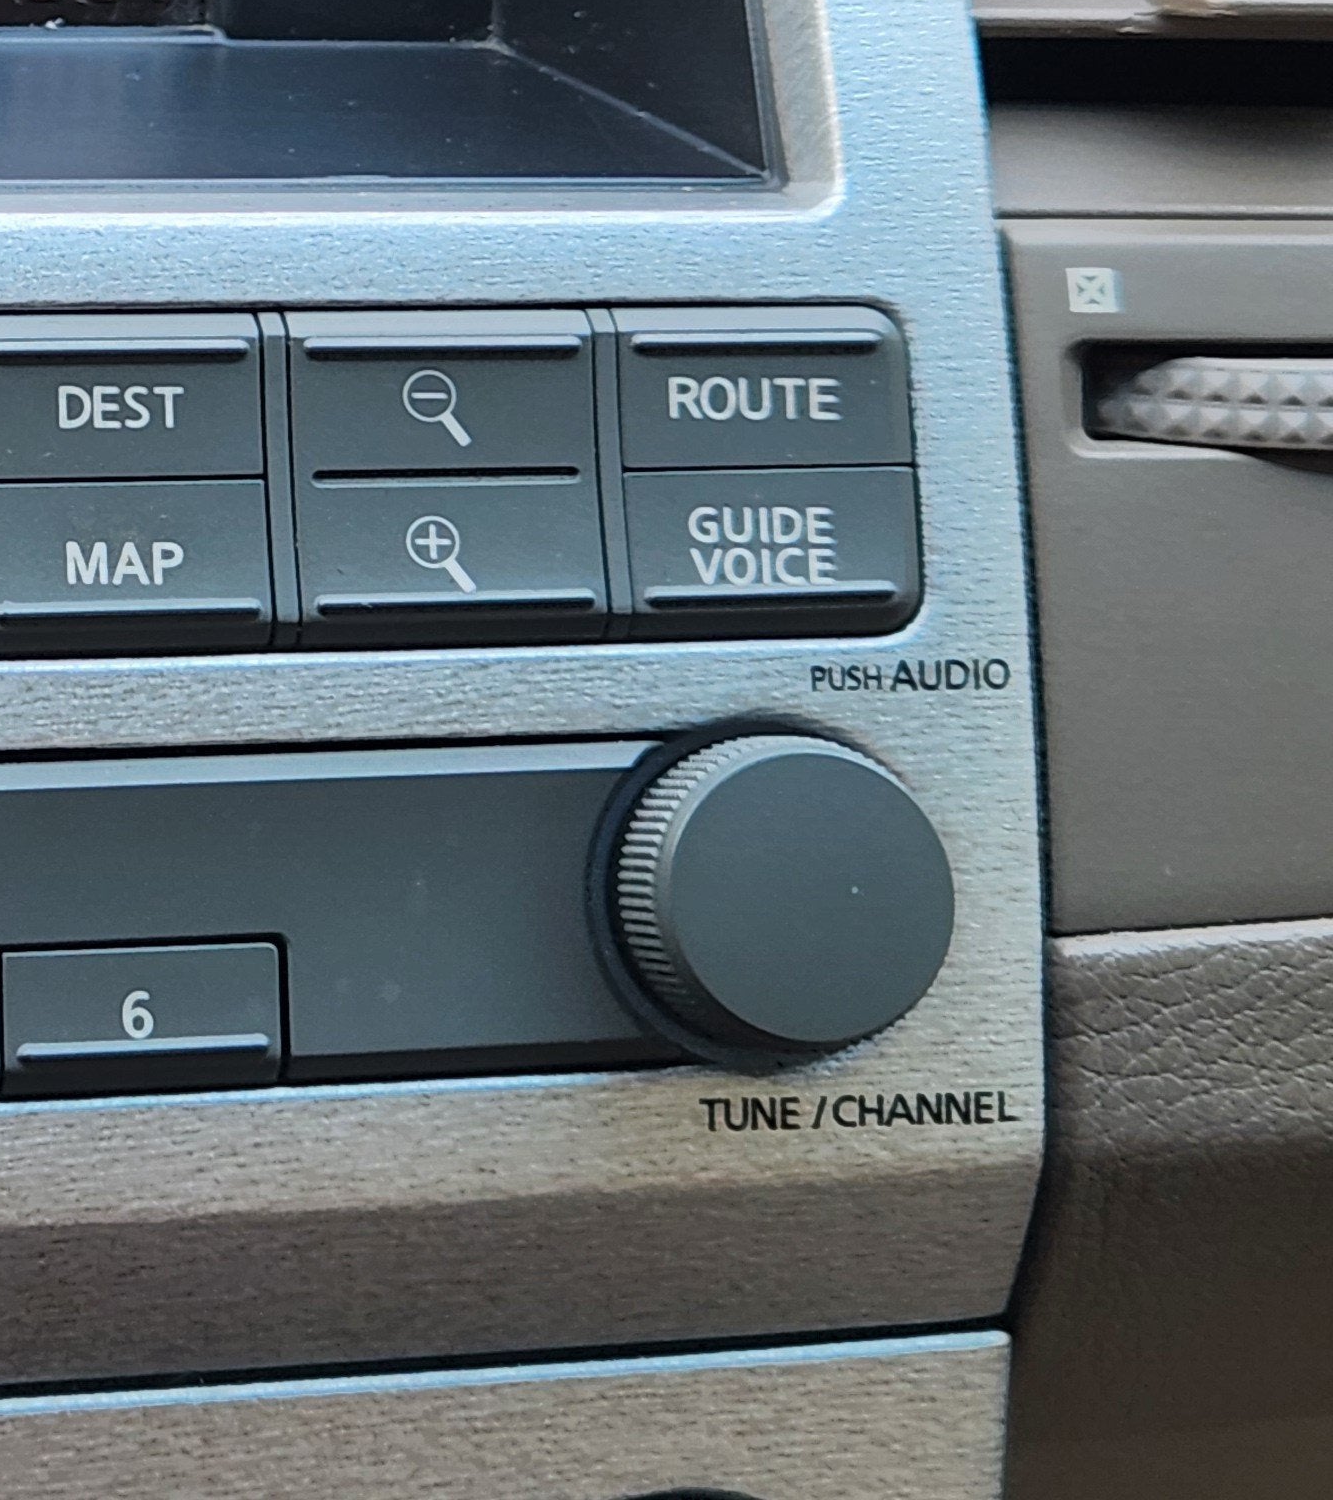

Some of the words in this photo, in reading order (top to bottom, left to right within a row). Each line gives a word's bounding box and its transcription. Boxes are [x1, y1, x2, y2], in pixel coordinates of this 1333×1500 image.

[57, 385, 185, 429] DEST
[668, 377, 842, 423] ROUTE
[687, 507, 837, 547] GUIDE
[65, 542, 186, 586] MAP
[689, 547, 837, 587] VOICE
[810, 664, 883, 692] PUSH
[889, 658, 1011, 692] AUDIO
[121, 990, 154, 1040] 6
